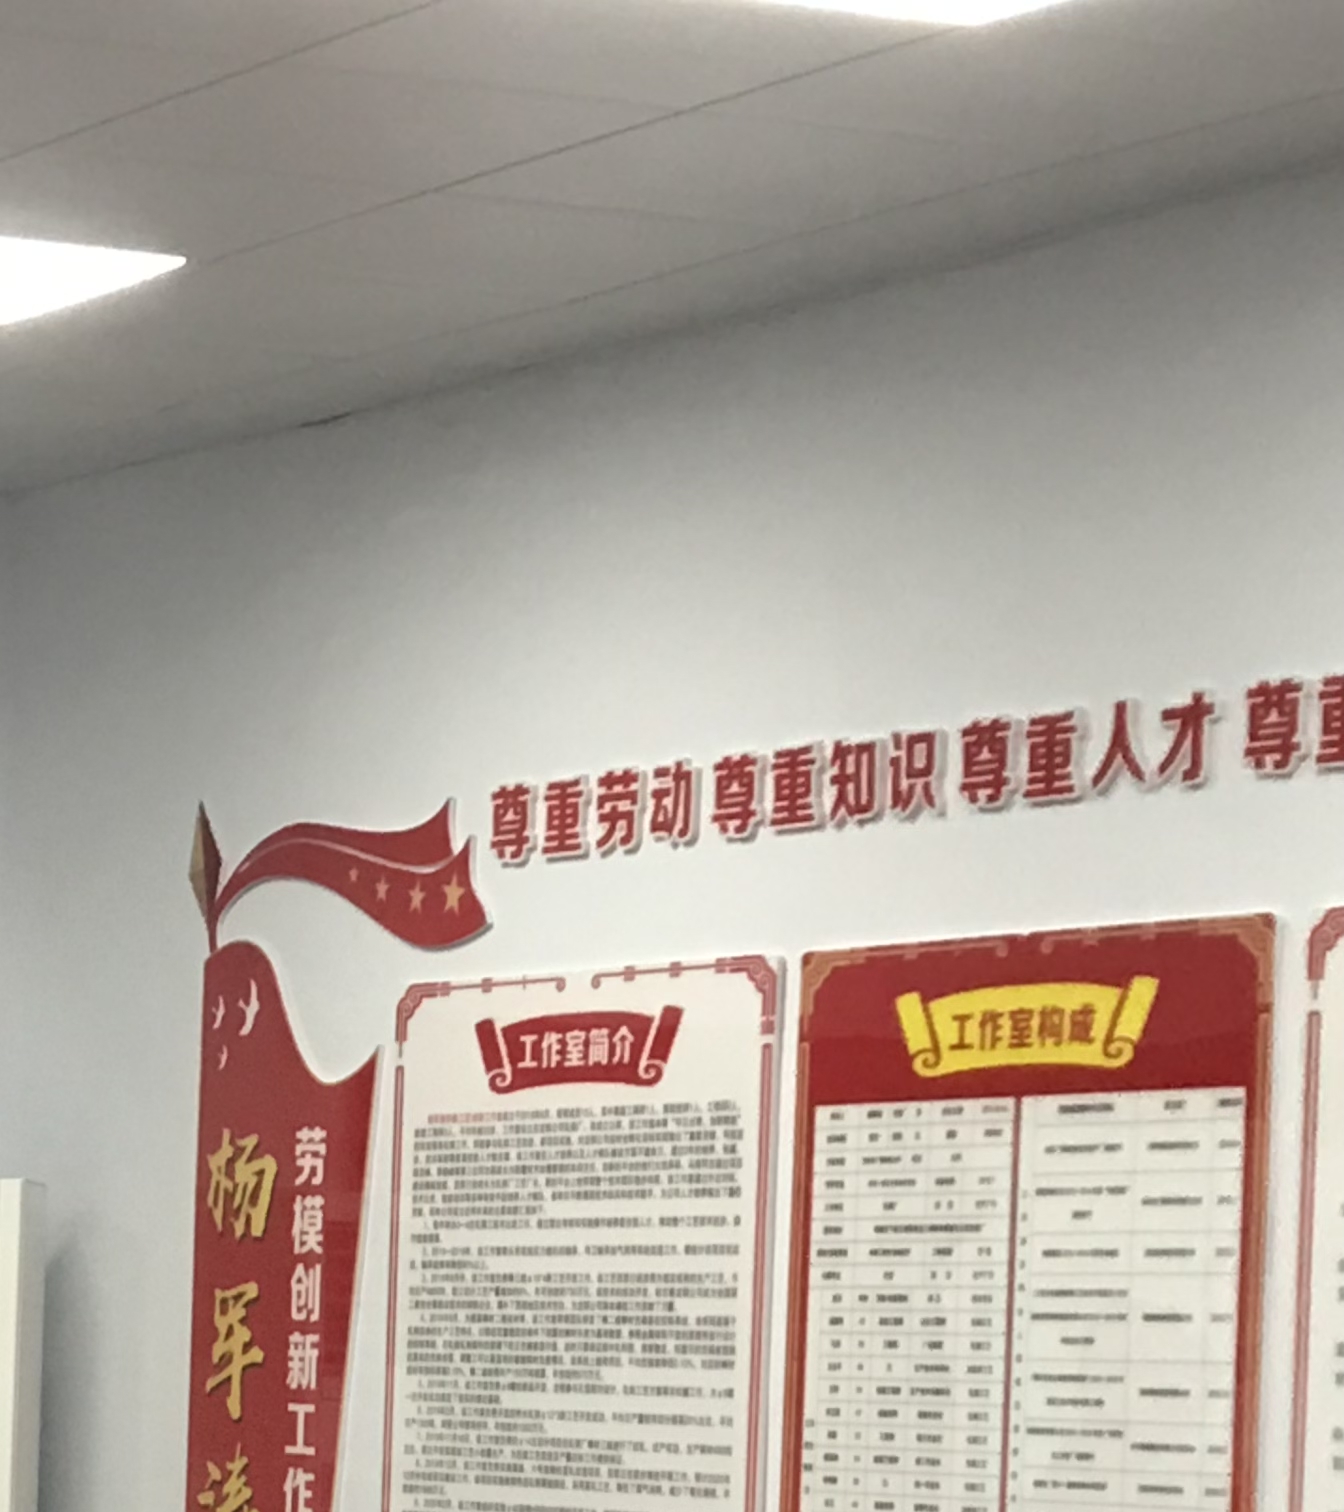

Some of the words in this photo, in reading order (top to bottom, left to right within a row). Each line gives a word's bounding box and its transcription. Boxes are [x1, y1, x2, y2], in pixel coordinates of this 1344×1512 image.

[490, 759, 694, 861] 尊重劳动
[711, 729, 937, 835] 尊重知识
[958, 690, 1216, 806] 尊重人才
[516, 1025, 635, 1069] 工作室简介
[948, 1003, 1098, 1051] 工作室构成
